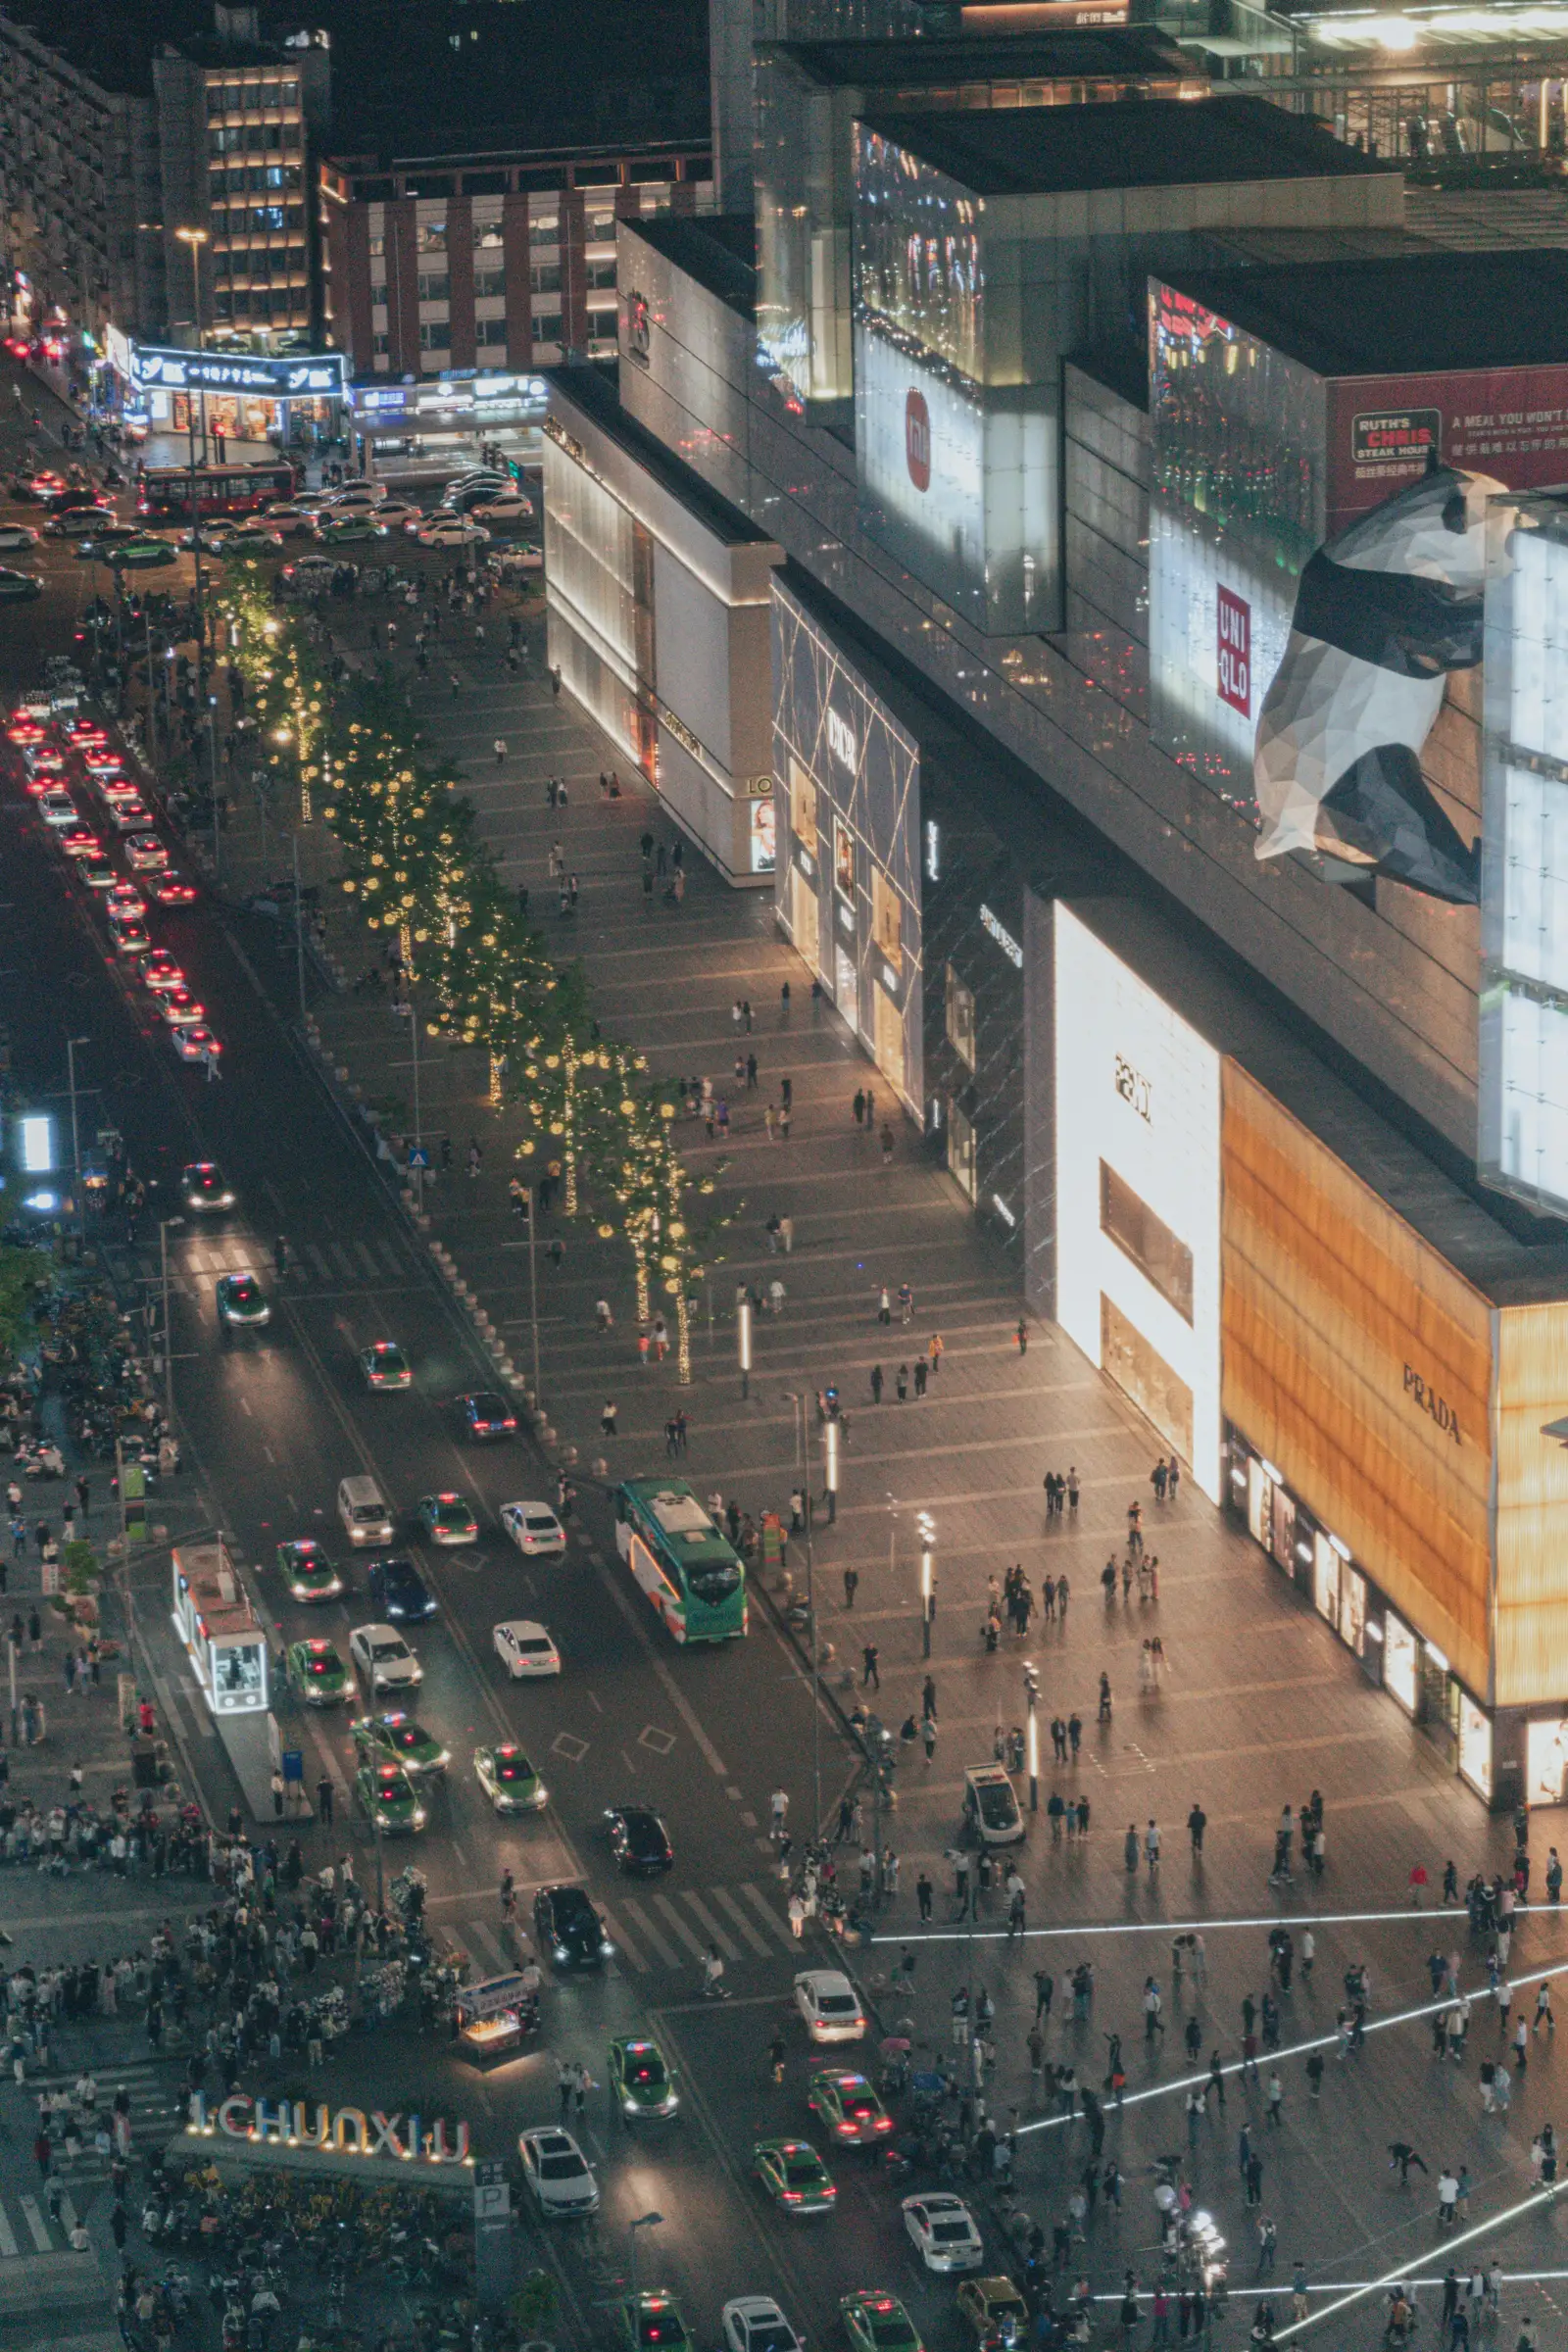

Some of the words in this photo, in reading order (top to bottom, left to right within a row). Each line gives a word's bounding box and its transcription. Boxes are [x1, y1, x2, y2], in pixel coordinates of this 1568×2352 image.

[1359, 417, 1410, 432] RUTH'S
[1452, 416, 1462, 428] A
[1464, 415, 1494, 427] MEAL
[1498, 413, 1524, 424] YOU
[1367, 427, 1432, 448] CHRIS
[1357, 447, 1396, 459] STEAK
[1398, 444, 1433, 456] HOUS
[1220, 600, 1245, 654] UNI
[1220, 648, 1247, 700] QLO
[1403, 1361, 1462, 1446] PRADA
